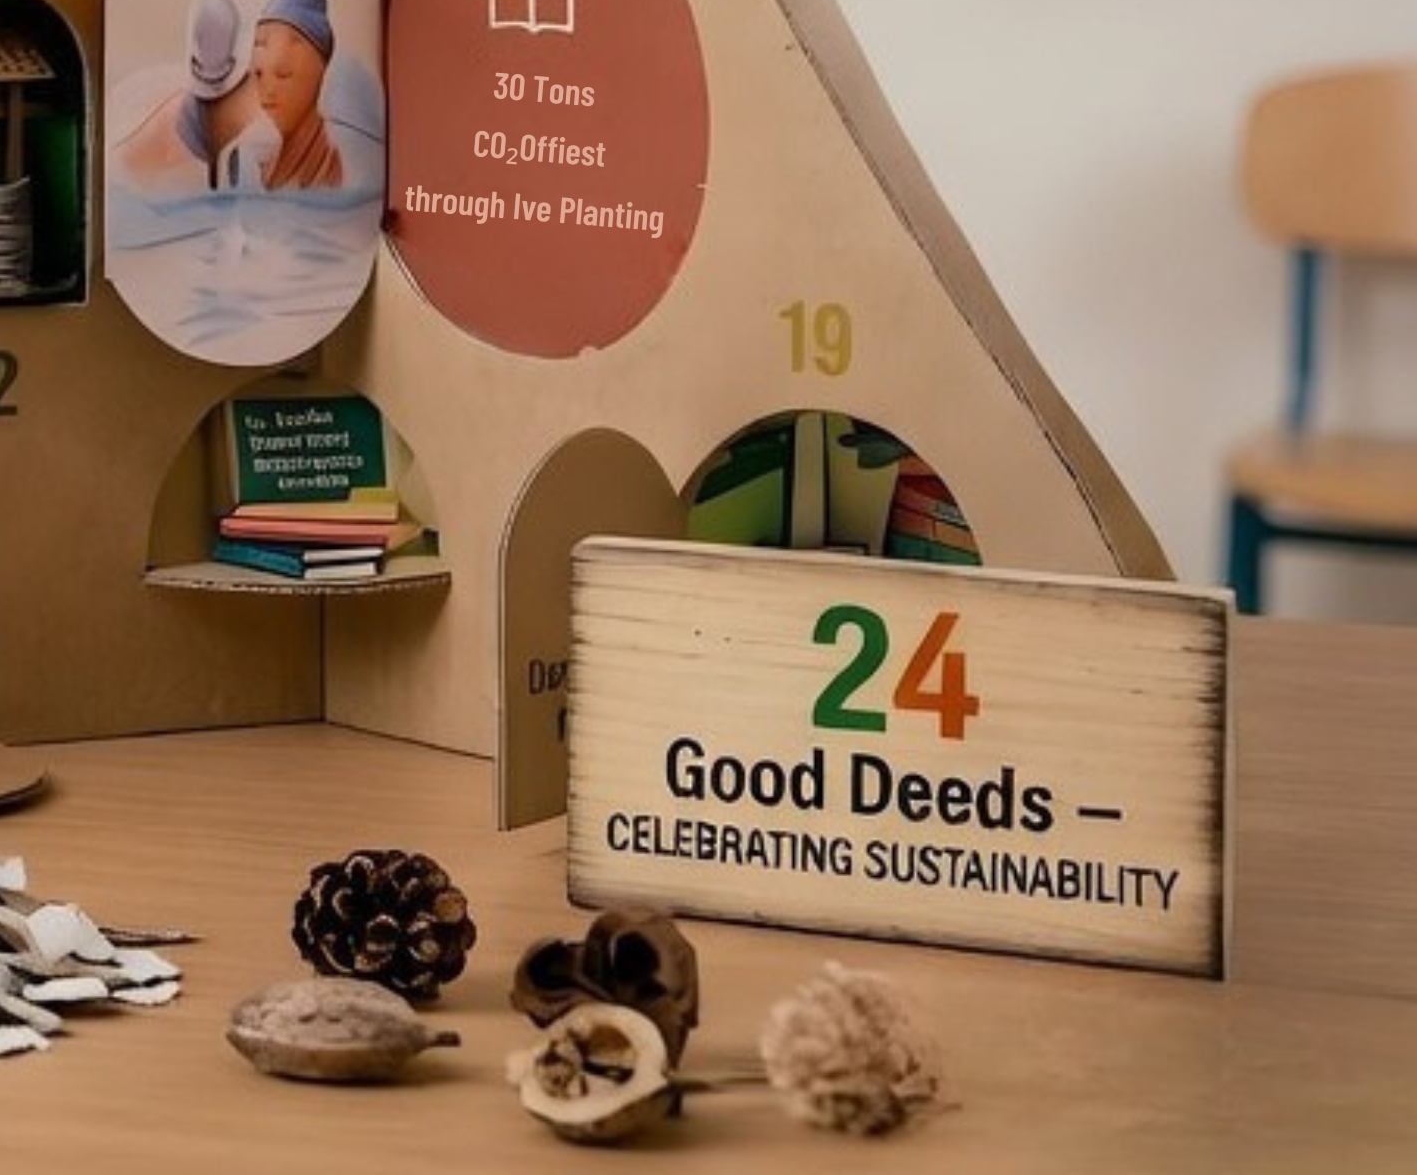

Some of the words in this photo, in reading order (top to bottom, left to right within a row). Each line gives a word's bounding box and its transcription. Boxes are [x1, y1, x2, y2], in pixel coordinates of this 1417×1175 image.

[493, 72, 526, 101] 30
[534, 76, 596, 107] Tons
[405, 185, 505, 225] through
[513, 193, 552, 223] Ive
[559, 197, 665, 239] Planting
[779, 299, 853, 376] 19
[812, 605, 980, 741] 24
[666, 738, 824, 810] Good
[851, 754, 1053, 832] Deeds
[607, 813, 852, 876] CELEBRATING
[864, 841, 1179, 911] SUSTAINABILITY
